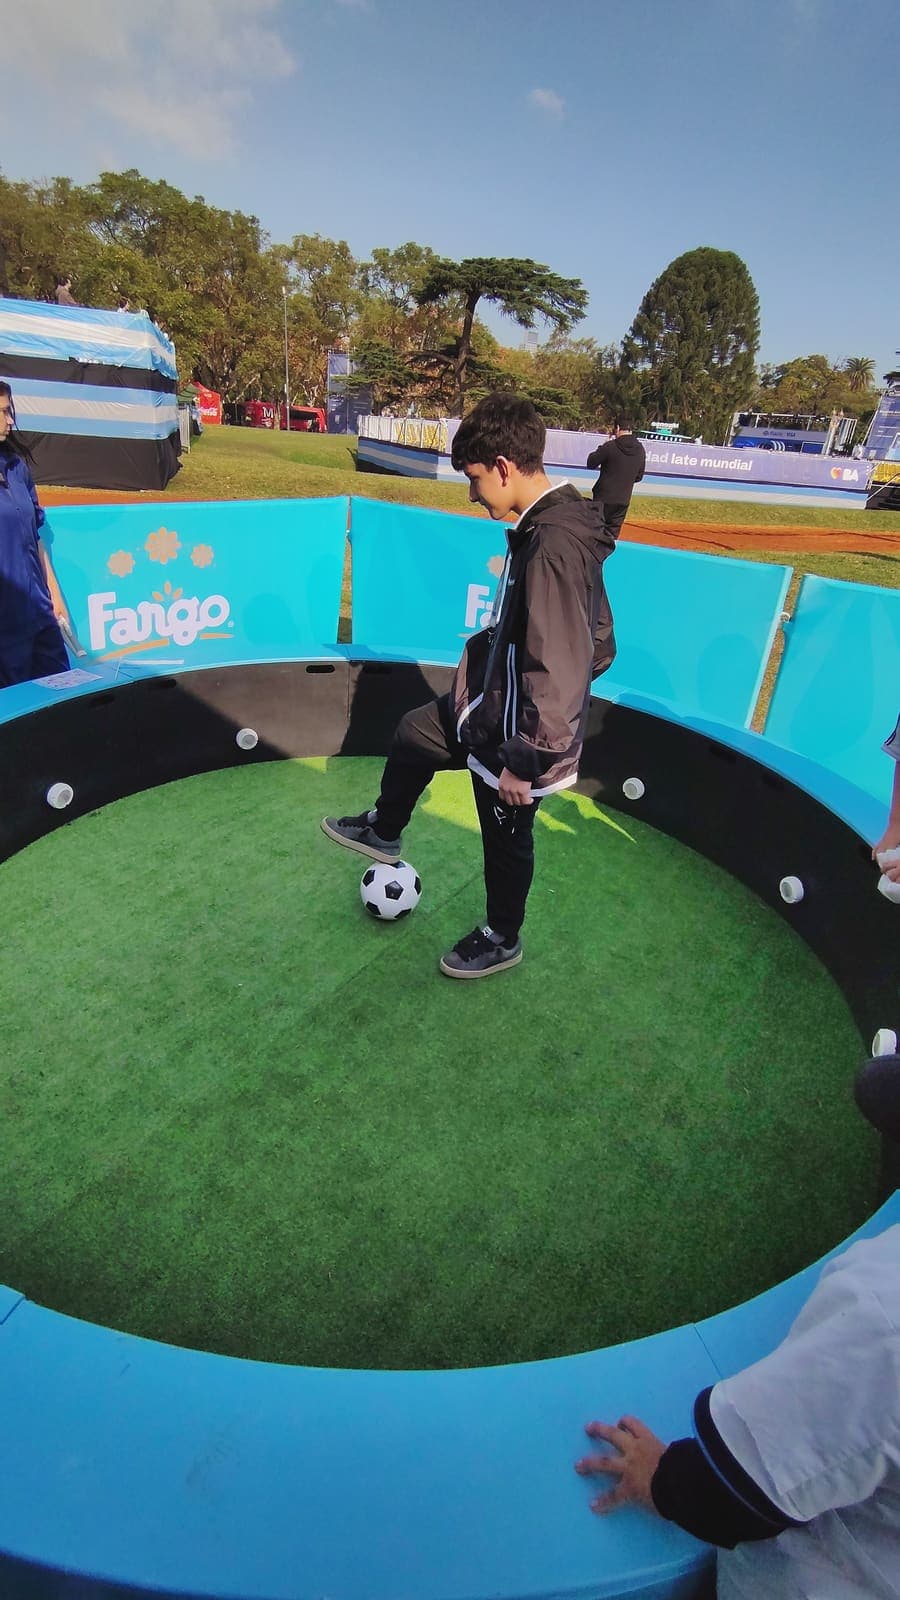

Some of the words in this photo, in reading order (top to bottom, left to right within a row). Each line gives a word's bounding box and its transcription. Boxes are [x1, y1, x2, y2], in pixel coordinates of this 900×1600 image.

[645, 451, 669, 464] dad
[671, 453, 698, 466] late
[700, 457, 753, 471] mundial
[842, 468, 858, 482] BA
